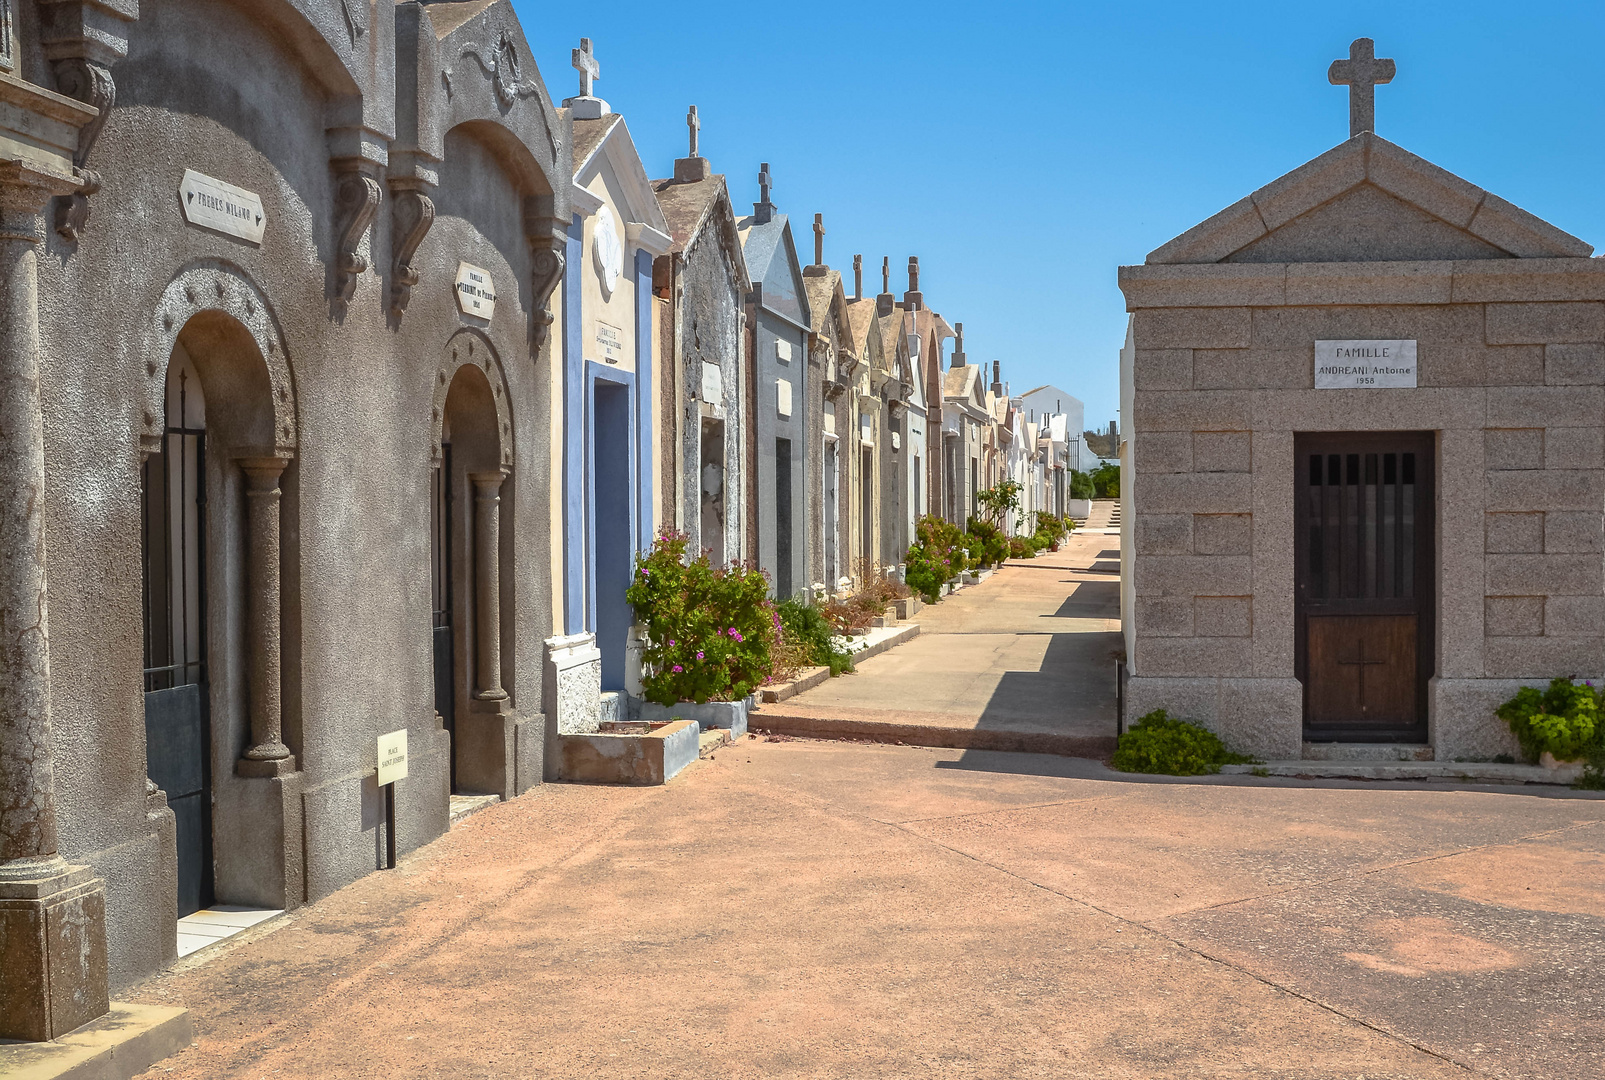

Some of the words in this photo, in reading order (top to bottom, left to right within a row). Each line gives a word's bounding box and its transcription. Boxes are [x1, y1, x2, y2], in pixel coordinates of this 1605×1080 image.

[225, 201, 251, 221] MILANO
[1336, 347, 1390, 358] FAMILLE
[1318, 366, 1368, 375] ANDREANI
[1372, 366, 1411, 375] Antoine
